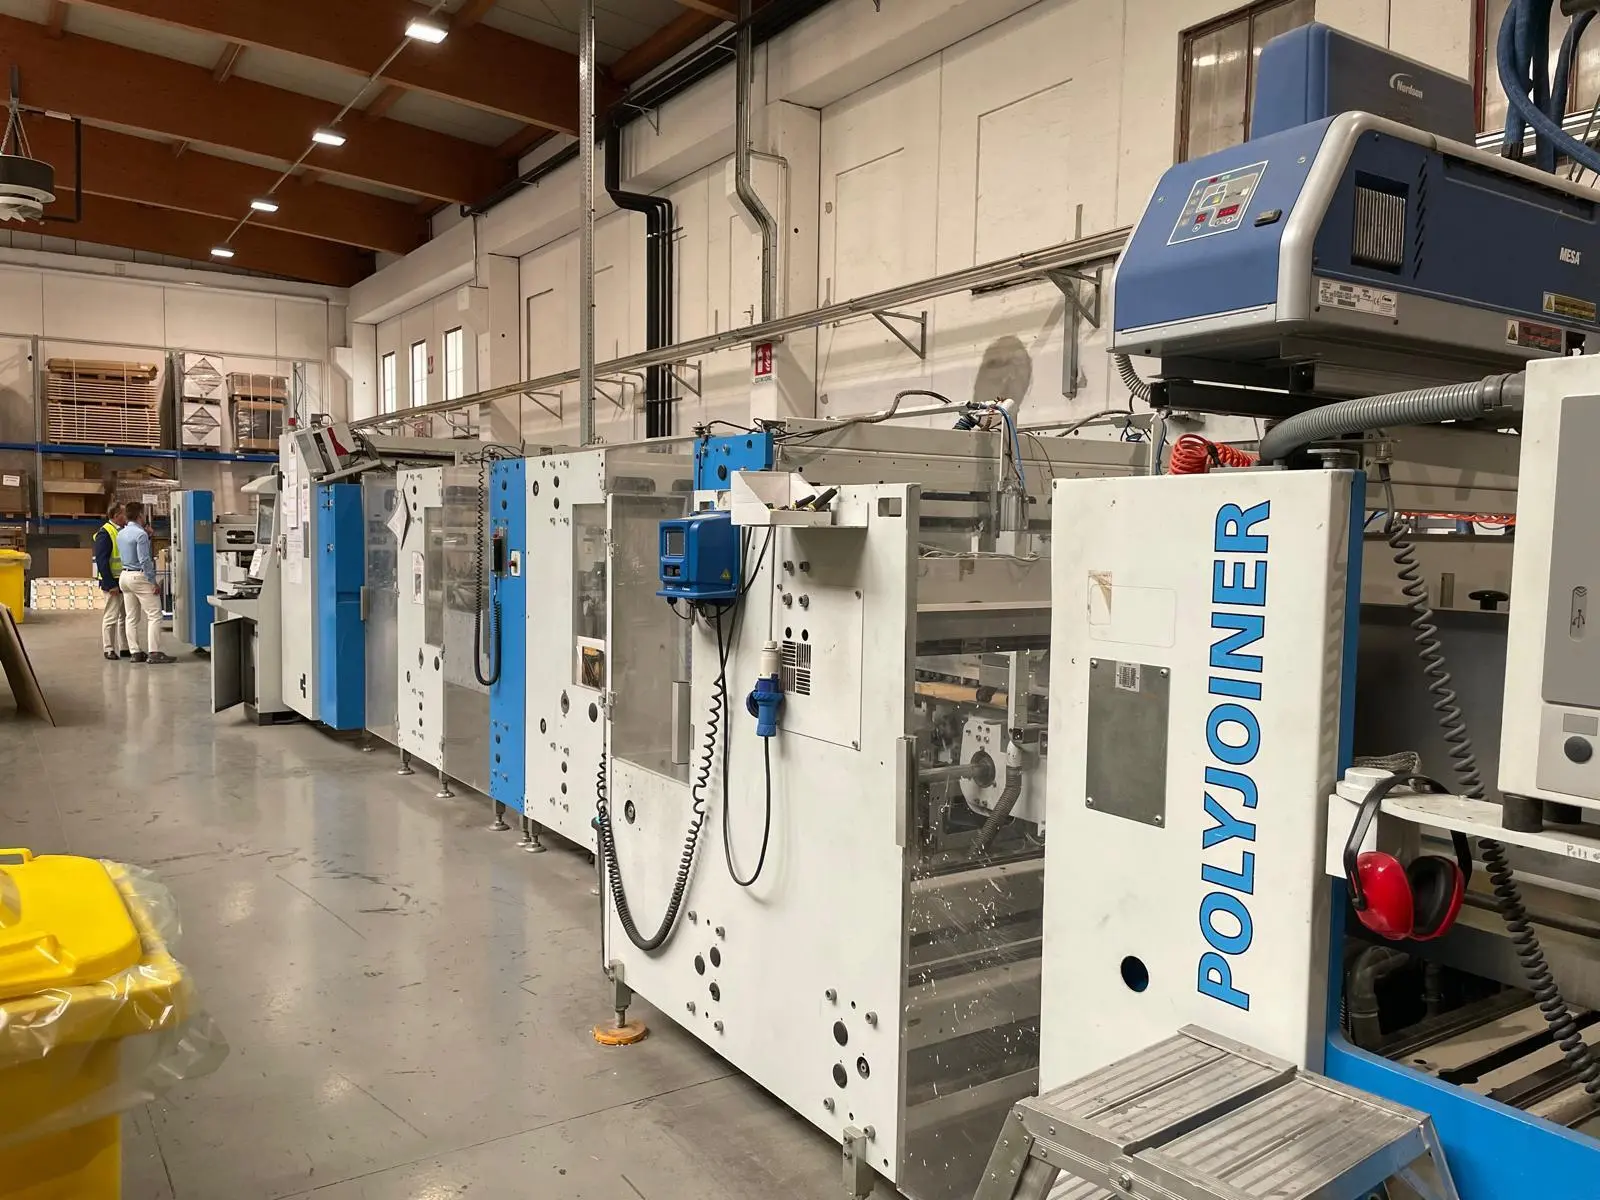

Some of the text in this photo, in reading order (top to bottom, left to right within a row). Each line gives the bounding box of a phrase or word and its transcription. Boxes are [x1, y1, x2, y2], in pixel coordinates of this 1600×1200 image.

[1397, 80, 1423, 99] Nordson
[1560, 247, 1580, 265] MESA
[1198, 500, 1272, 1011] POLYJOINER
